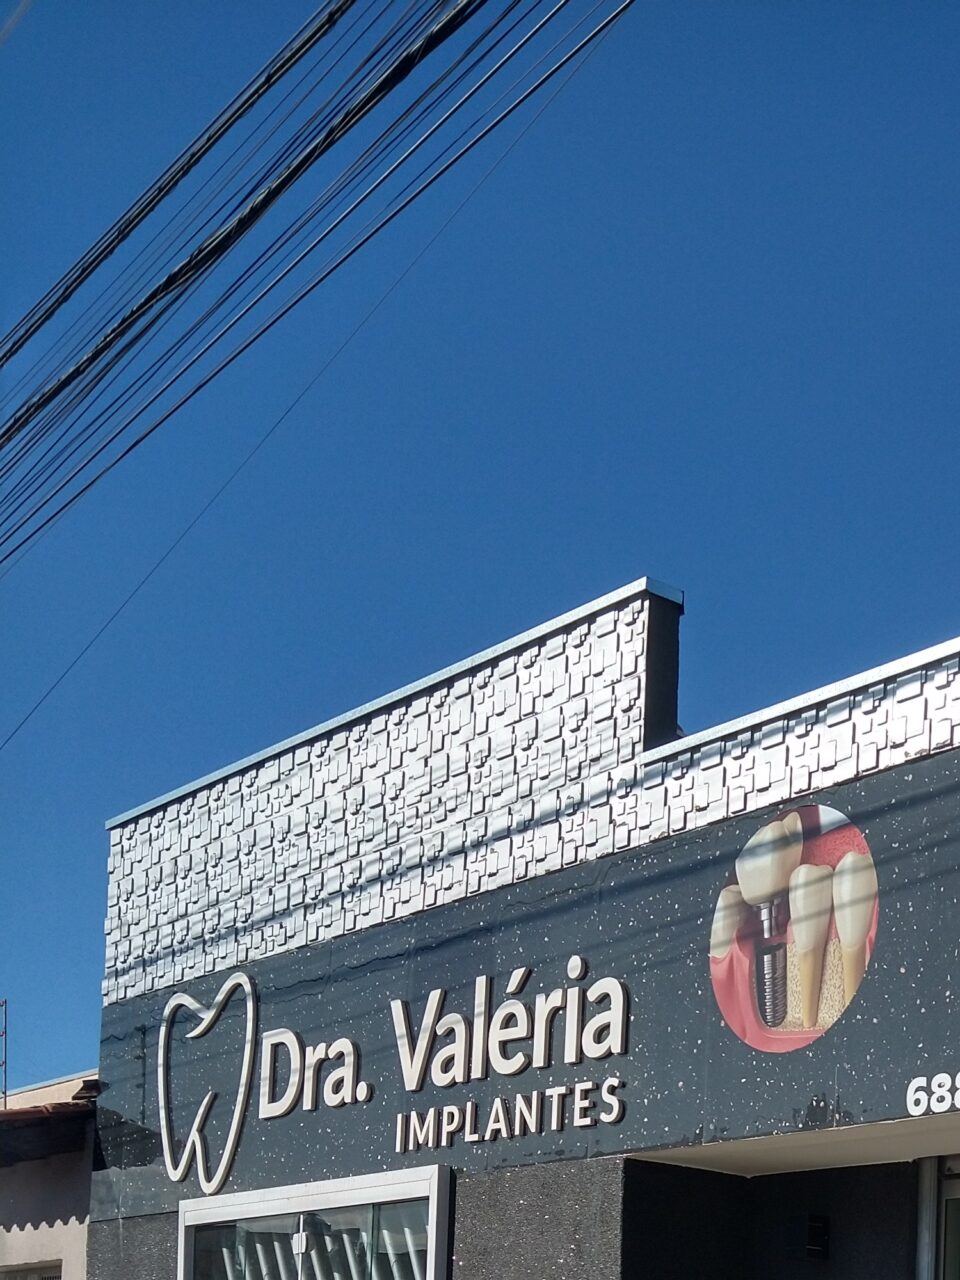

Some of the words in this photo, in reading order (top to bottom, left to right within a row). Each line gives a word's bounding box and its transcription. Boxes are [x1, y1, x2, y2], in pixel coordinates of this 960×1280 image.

[259, 1028, 372, 1120] Dra.
[390, 954, 629, 1092] Valéria
[395, 1077, 625, 1153] IMPLANTES
